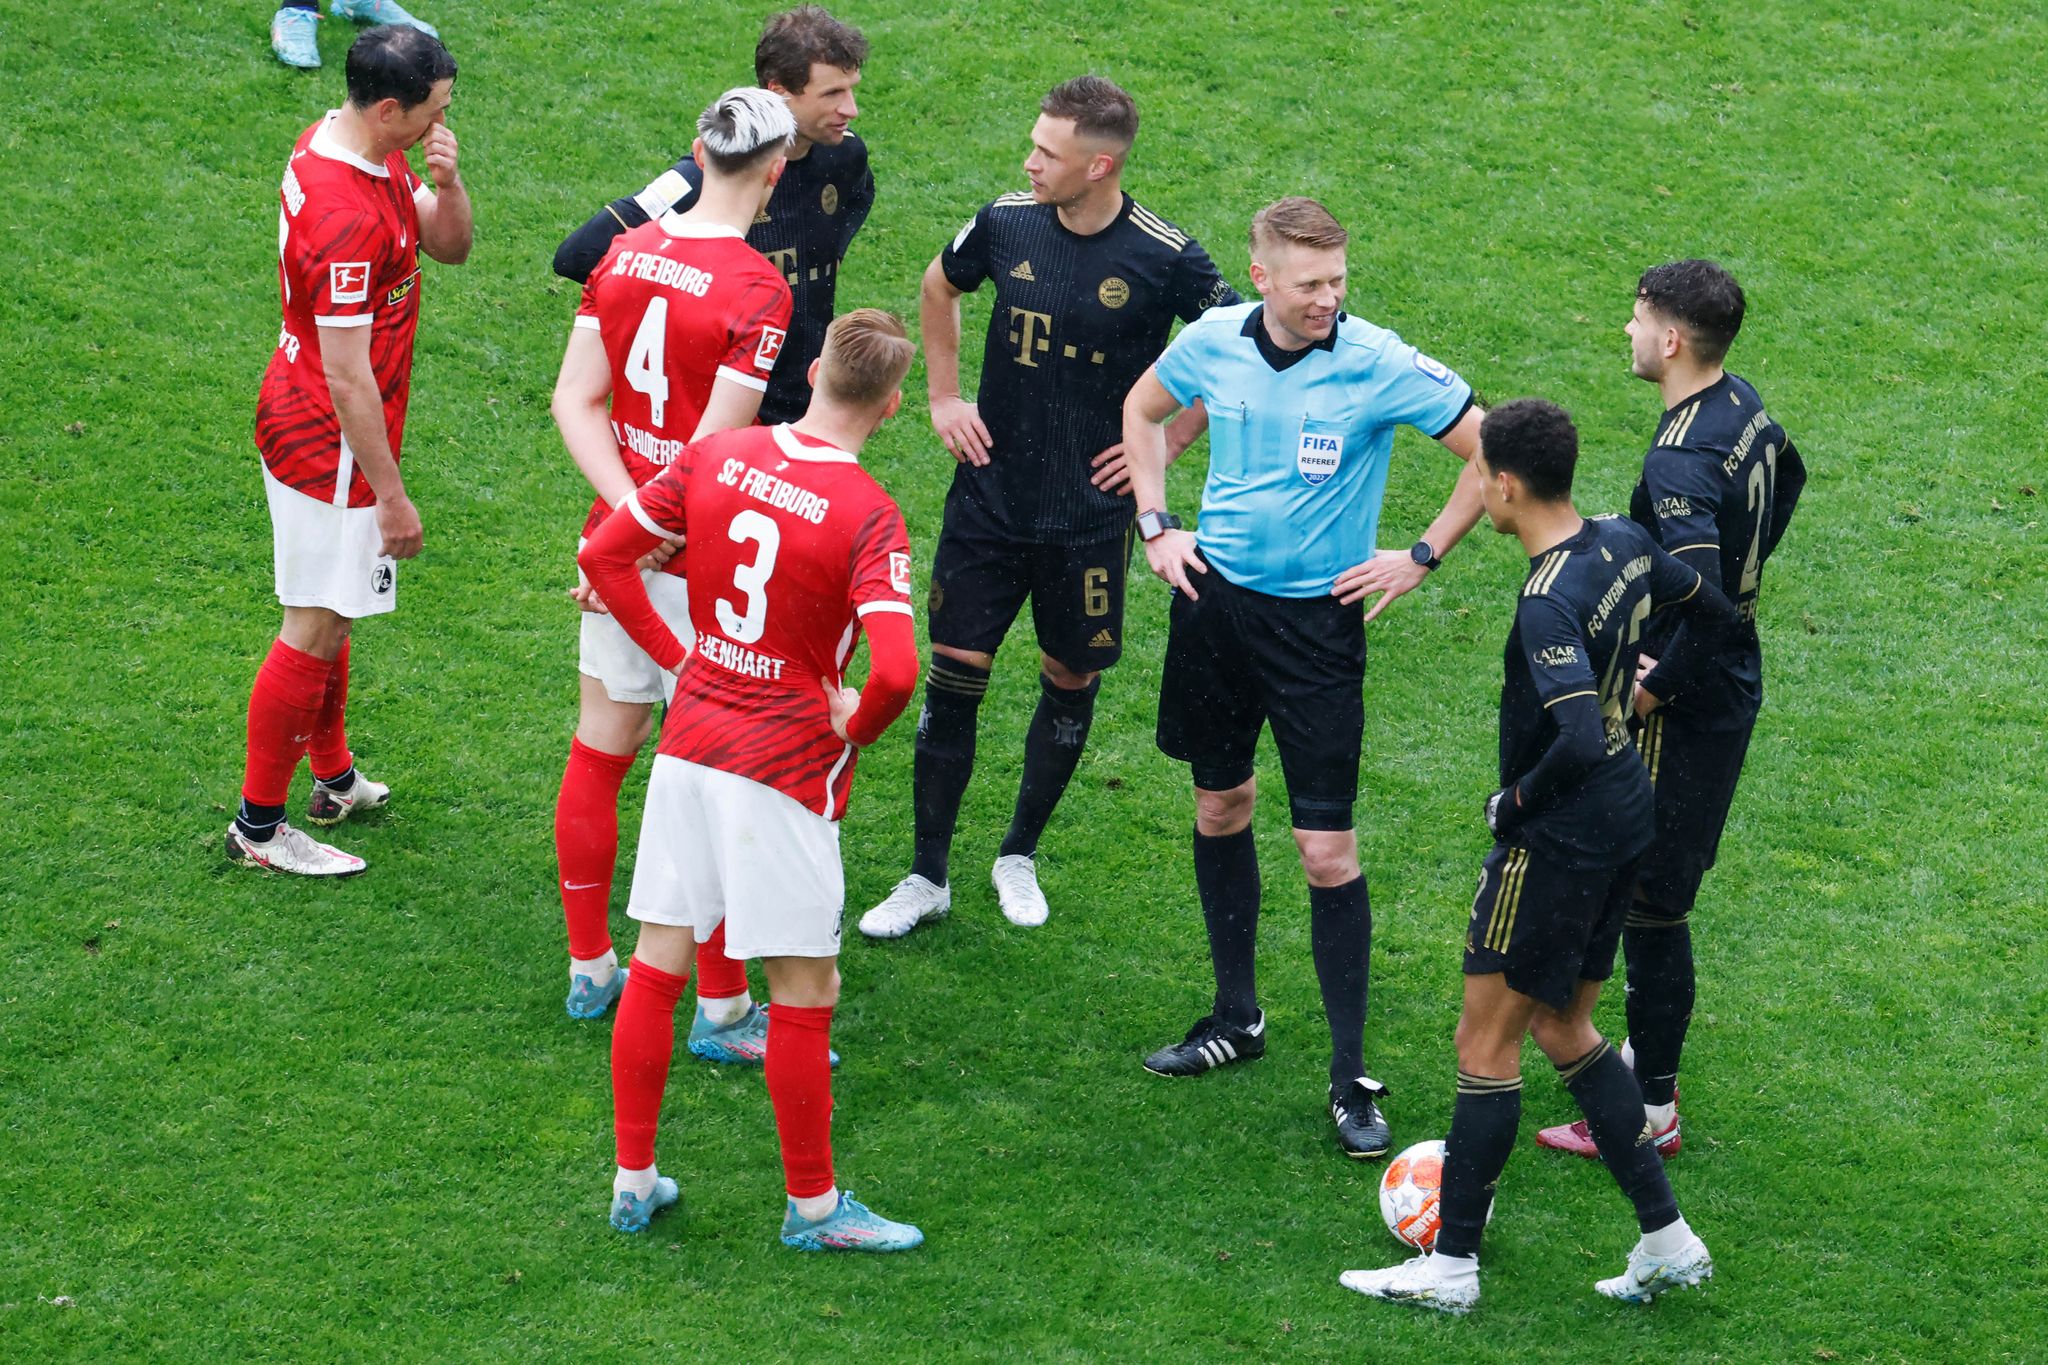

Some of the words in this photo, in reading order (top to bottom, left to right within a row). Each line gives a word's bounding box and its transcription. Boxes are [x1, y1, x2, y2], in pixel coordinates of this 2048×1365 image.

[611, 250, 634, 275] SC
[627, 252, 713, 297] FREIBURG
[624, 296, 669, 429] 4
[1301, 456, 1336, 466] REFEREE
[1303, 436, 1338, 451] FIFA
[1722, 454, 1739, 477] FC
[717, 458, 745, 486] SC
[739, 467, 829, 524] FREIBURG
[1653, 497, 1690, 515] QATAR
[715, 509, 780, 644] 3
[1084, 567, 1109, 617] 6
[1588, 614, 1603, 639] FC
[1597, 576, 1627, 621] BAYERN
[1533, 645, 1577, 665] QATAR
